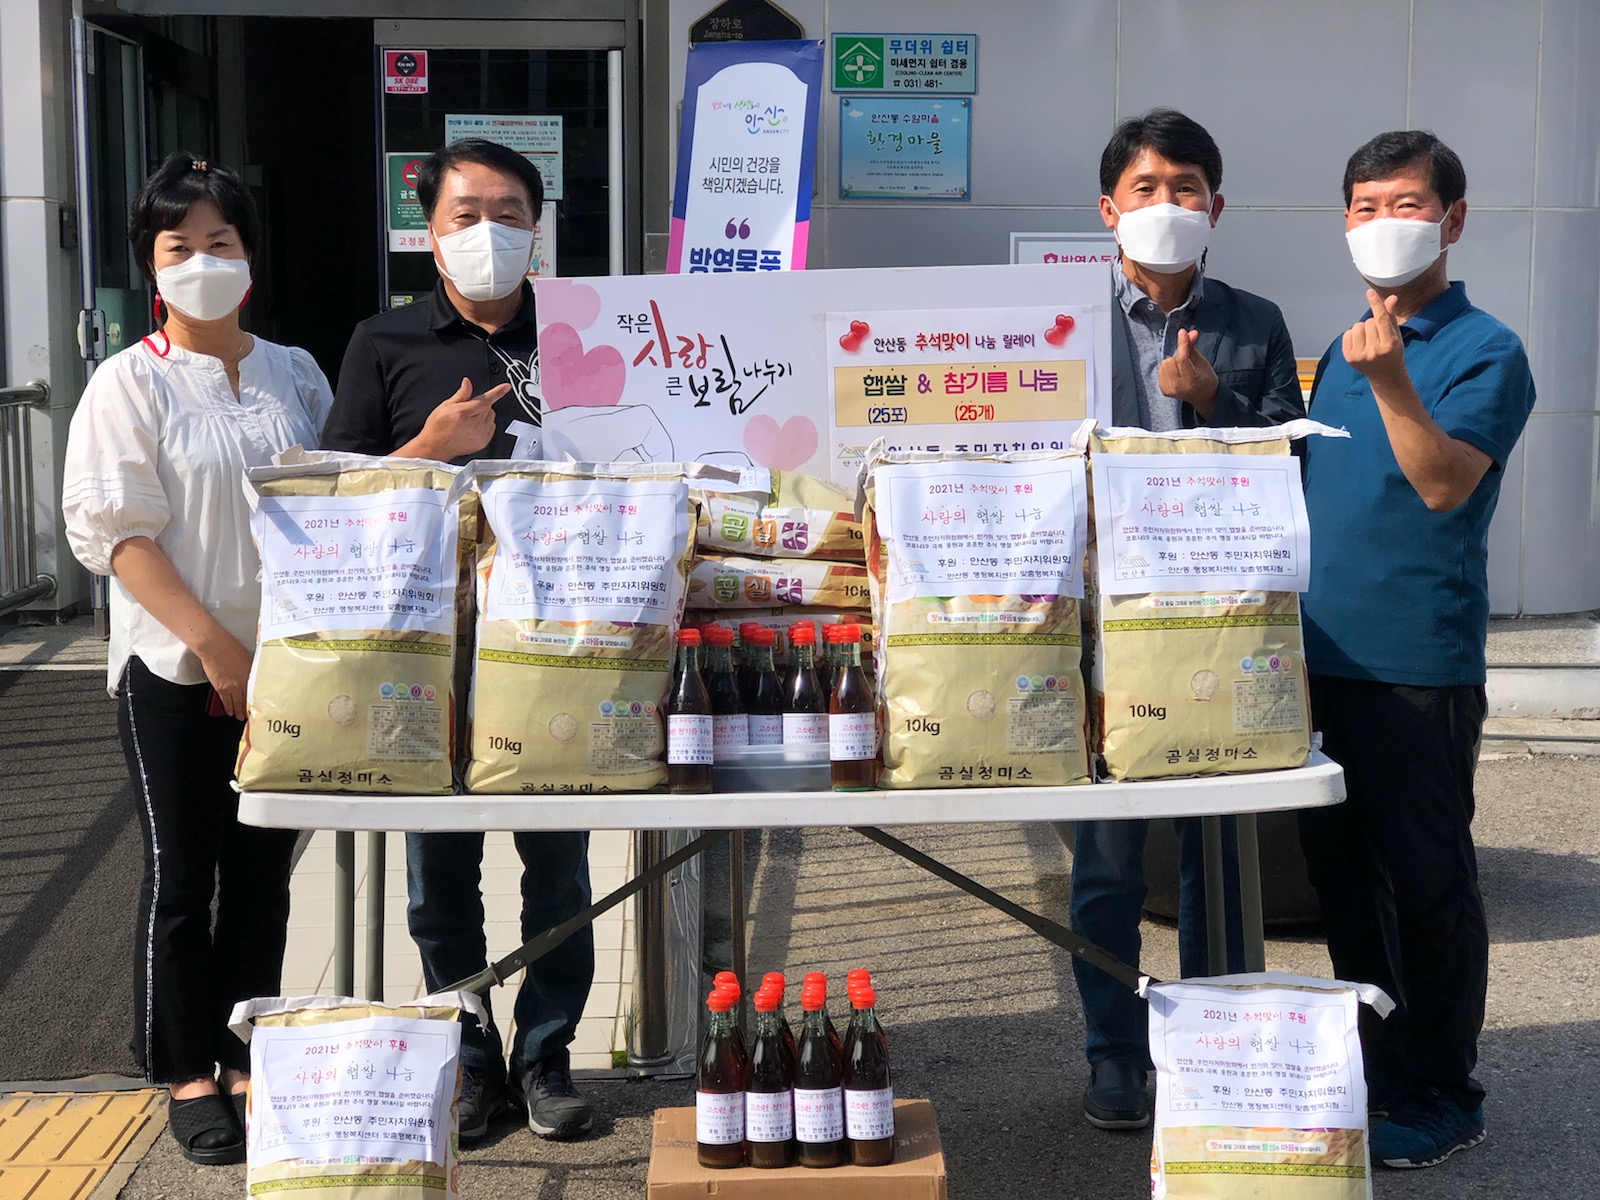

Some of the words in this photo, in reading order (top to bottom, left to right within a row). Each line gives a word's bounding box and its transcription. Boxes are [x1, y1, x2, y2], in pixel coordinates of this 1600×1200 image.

[710, 17, 743, 30] 장하로
[704, 30, 743, 39] Jangha-ro
[890, 40, 932, 55] 무더위
[941, 40, 968, 55] 쉼터
[891, 58, 925, 68] 미세먼지
[930, 58, 946, 68] 쉼터
[951, 58, 968, 69] 겸용
[904, 79, 921, 88] 031)
[925, 79, 942, 88] 481-
[872, 114, 898, 123] 안산동
[903, 114, 939, 123] 수암마을
[866, 131, 943, 154] 환경마을
[709, 157, 743, 173] 시민의
[747, 157, 780, 173] 건강을
[702, 177, 783, 194] 책임지겠습니다.
[400, 190, 416, 199] 금연
[399, 237, 425, 246] 고정문
[617, 313, 652, 333] 작은
[633, 299, 714, 369] 사랑
[874, 338, 906, 352] 안산동
[915, 332, 969, 351] 추석맞이
[975, 336, 996, 350] 나눔
[1002, 334, 1035, 350] 릴레이
[665, 376, 682, 396] 큰
[743, 359, 792, 385] 나누기
[863, 374, 908, 396] 햅쌀
[918, 374, 932, 394] &
[944, 371, 1008, 394] 참기름
[1019, 370, 1058, 392] 나눔
[868, 407, 908, 424] (25포)
[954, 404, 994, 422] (25개)
[929, 484, 964, 494] 2021년
[969, 484, 1008, 495] 추석맞이
[1014, 484, 1033, 494] 후원
[1147, 477, 1181, 487] 2021년
[1186, 477, 1225, 487] 추석맞이
[1230, 477, 1250, 487] 후원
[533, 506, 569, 515] 2021년
[574, 504, 612, 514] 추석맞이
[617, 505, 637, 515] 후원
[921, 509, 966, 525] 사랑의
[976, 509, 1005, 525] 햅쌀
[1015, 509, 1043, 522] 나눔
[1141, 502, 1184, 517] 사랑의
[1195, 502, 1223, 517] 햅쌀
[1232, 503, 1261, 516] 나눔
[304, 519, 339, 529] 2021년
[388, 511, 407, 523] 후원
[523, 530, 567, 545] 사랑의
[577, 529, 607, 545] 햅쌀
[617, 531, 645, 545] 나눔
[294, 544, 339, 560] 사랑의
[350, 542, 378, 559] 햅쌀
[1158, 551, 1177, 561] 후원
[1190, 551, 1218, 560] 안산동
[1224, 550, 1291, 559] 주민자치위원회
[937, 559, 957, 567] 후원
[970, 557, 998, 566] 안산동
[1003, 555, 1071, 566] 주민자치위원회
[947, 572, 969, 580] 안산동
[1168, 566, 1190, 574] 안산동
[536, 581, 554, 591] 후원
[568, 582, 596, 591] 안산동
[601, 582, 667, 592] 주민자치위원회
[305, 592, 325, 601] 후원
[338, 591, 367, 600] 안산동
[373, 588, 434, 602] 주민자치위원회
[544, 596, 565, 604] 안산동
[313, 606, 335, 614] 안산동
[1129, 704, 1166, 720] 10kg
[267, 720, 301, 738] 10kg
[905, 718, 940, 735] 10kg
[488, 736, 522, 754] 10kg
[1166, 747, 1258, 764] 곰실정미소
[297, 769, 393, 785] 곰실정미소
[939, 766, 1032, 780] 곰실정미소
[1203, 1010, 1238, 1022] 2021년
[1243, 1011, 1283, 1022] 추석맞이
[1288, 1011, 1306, 1024] 후원
[305, 1045, 340, 1055] 2021년
[345, 1039, 382, 1051] 추석맞이
[388, 1039, 408, 1052] 후원
[1196, 1035, 1240, 1051] 사랑의
[1250, 1035, 1279, 1052] 햅쌀
[1289, 1039, 1317, 1055] 나눔
[292, 1068, 337, 1085] 사랑의
[346, 1064, 376, 1080] 햅쌀
[386, 1066, 415, 1081] 나눔
[1212, 1085, 1231, 1095] 후원
[1244, 1087, 1273, 1097] 안산동
[1279, 1086, 1346, 1099] 주민자치위원회
[1221, 1101, 1243, 1109] 안산동
[302, 1118, 321, 1128] 후원
[333, 1115, 363, 1125] 안산동
[368, 1116, 435, 1128] 주민자치위원회
